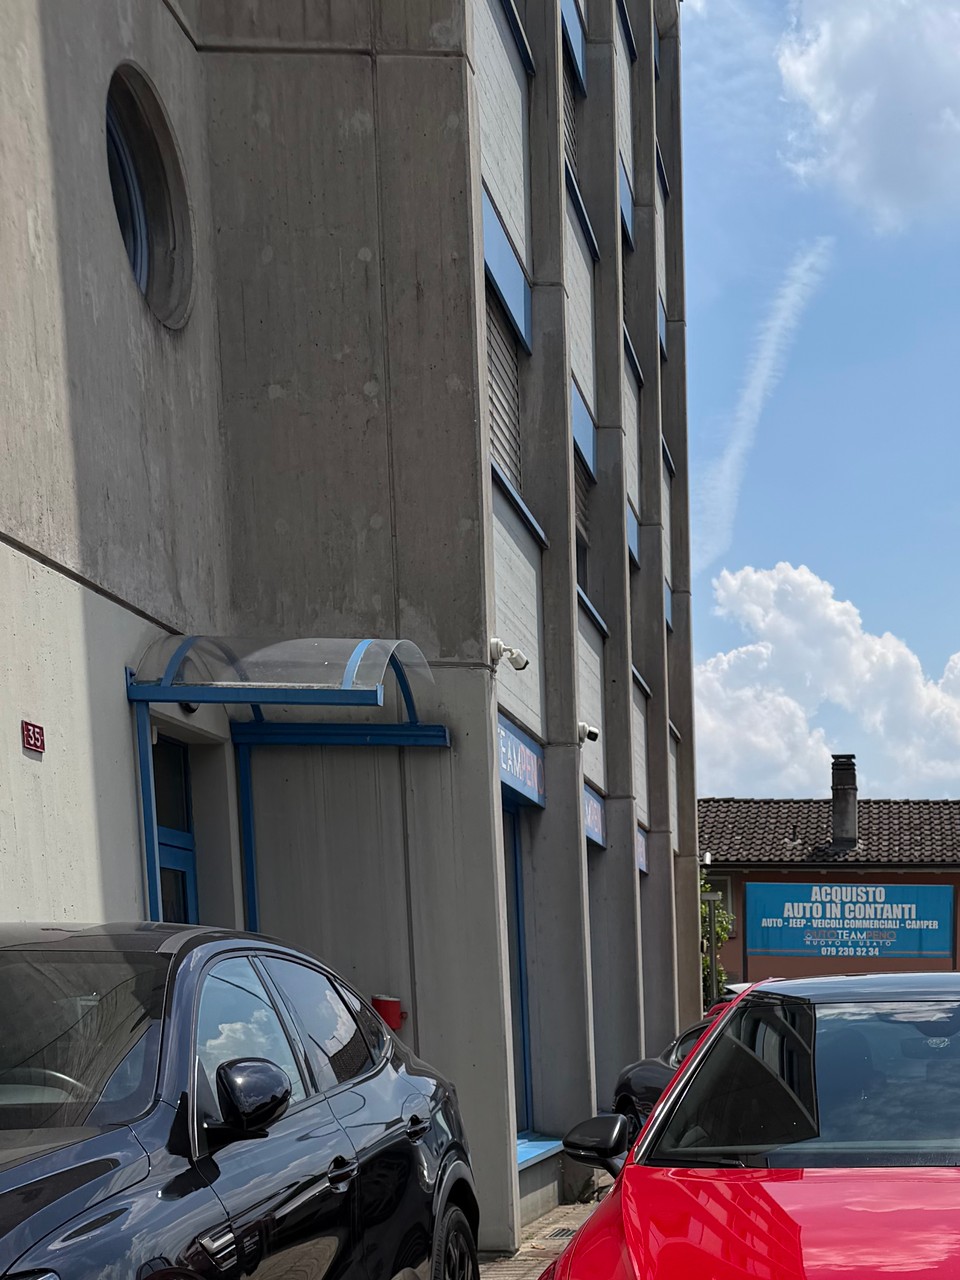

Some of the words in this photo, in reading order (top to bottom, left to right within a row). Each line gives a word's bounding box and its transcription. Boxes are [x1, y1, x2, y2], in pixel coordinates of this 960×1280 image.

[28, 726, 42, 746] 35
[498, 727, 545, 795] EAMPENO
[811, 886, 886, 903] ACQUISTO
[783, 902, 823, 918] AUTO
[826, 903, 841, 918] IN
[844, 903, 917, 919] CONTANTI
[761, 918, 782, 927] AUTO
[789, 918, 806, 928] JEEP
[812, 918, 843, 928] VEICOLI
[844, 919, 900, 929] COMMERCIALI
[906, 919, 939, 929] CAMPER
[821, 947, 837, 956] 079
[838, 947, 854, 956] 230
[856, 947, 867, 956] 32
[868, 947, 879, 956] 34
